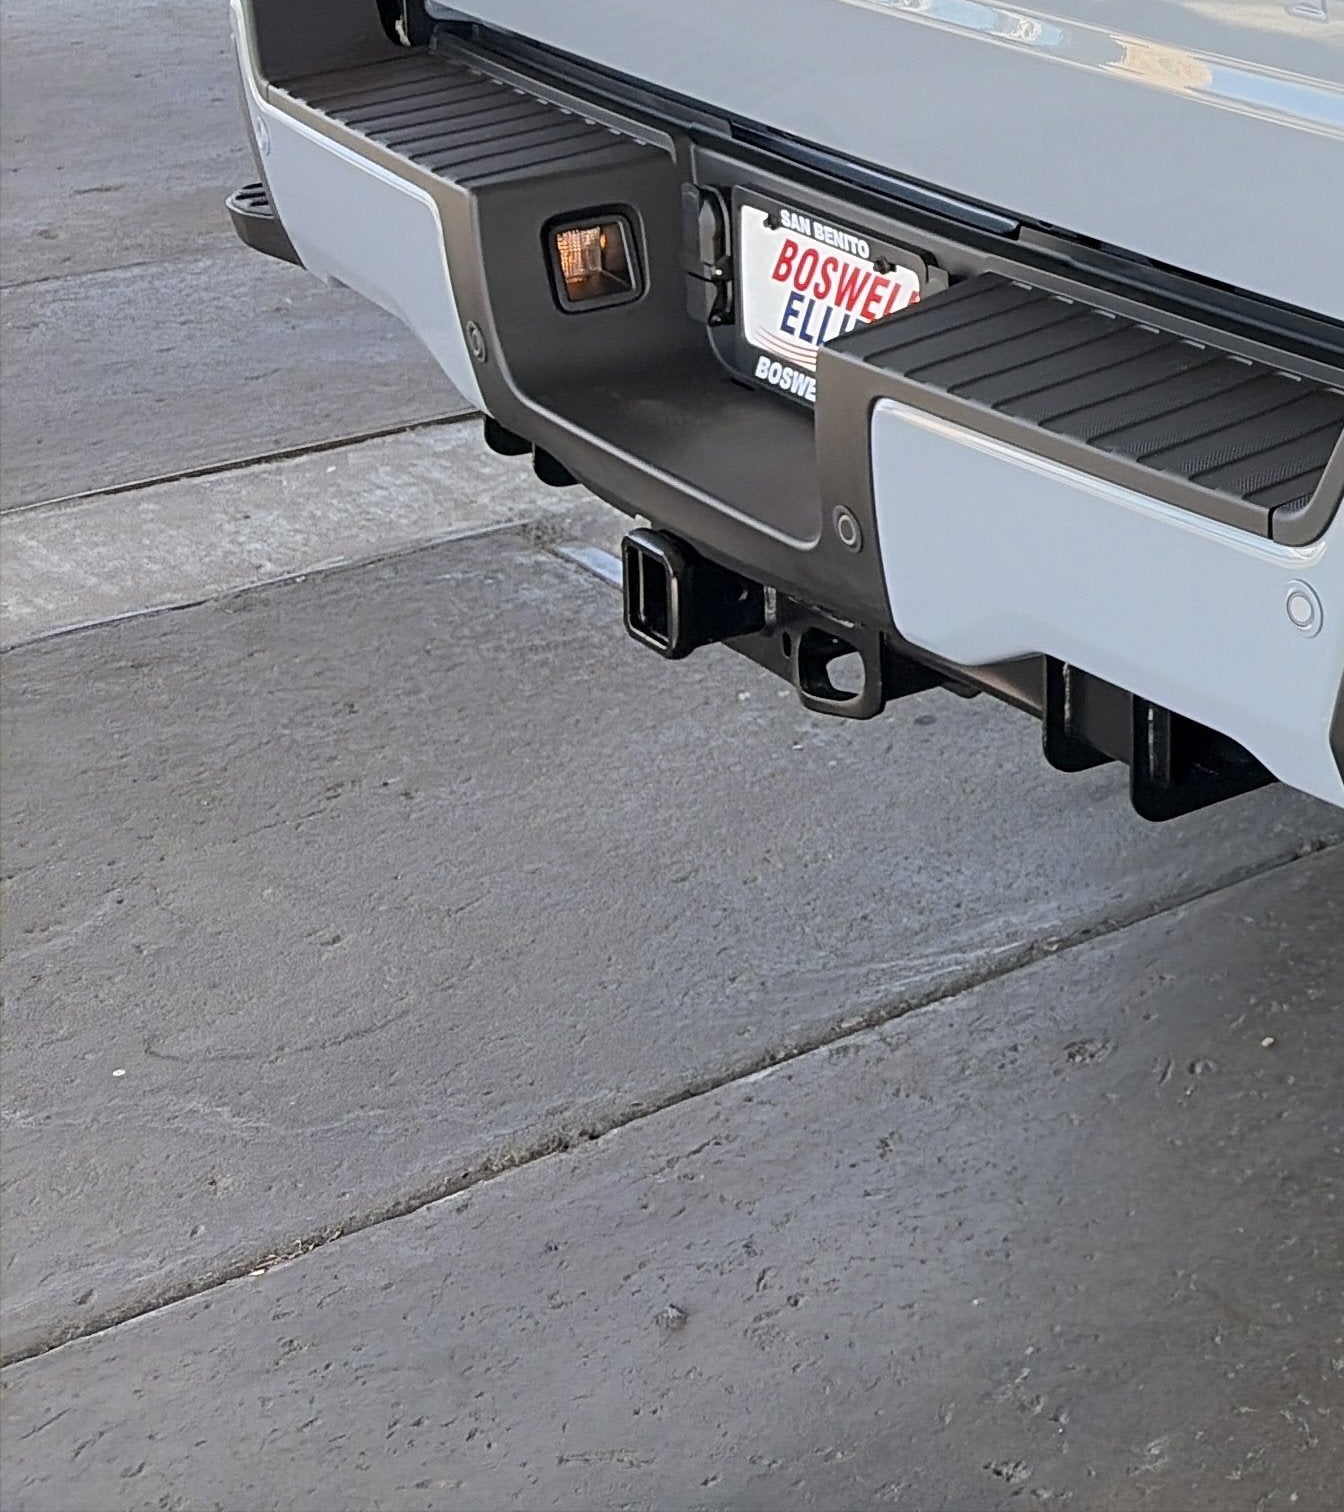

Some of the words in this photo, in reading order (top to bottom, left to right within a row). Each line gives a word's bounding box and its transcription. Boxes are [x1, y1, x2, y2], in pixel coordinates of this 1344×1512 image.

[780, 208, 811, 236] SAN
[812, 221, 870, 259] BENITO
[771, 239, 921, 321] BOSWEL
